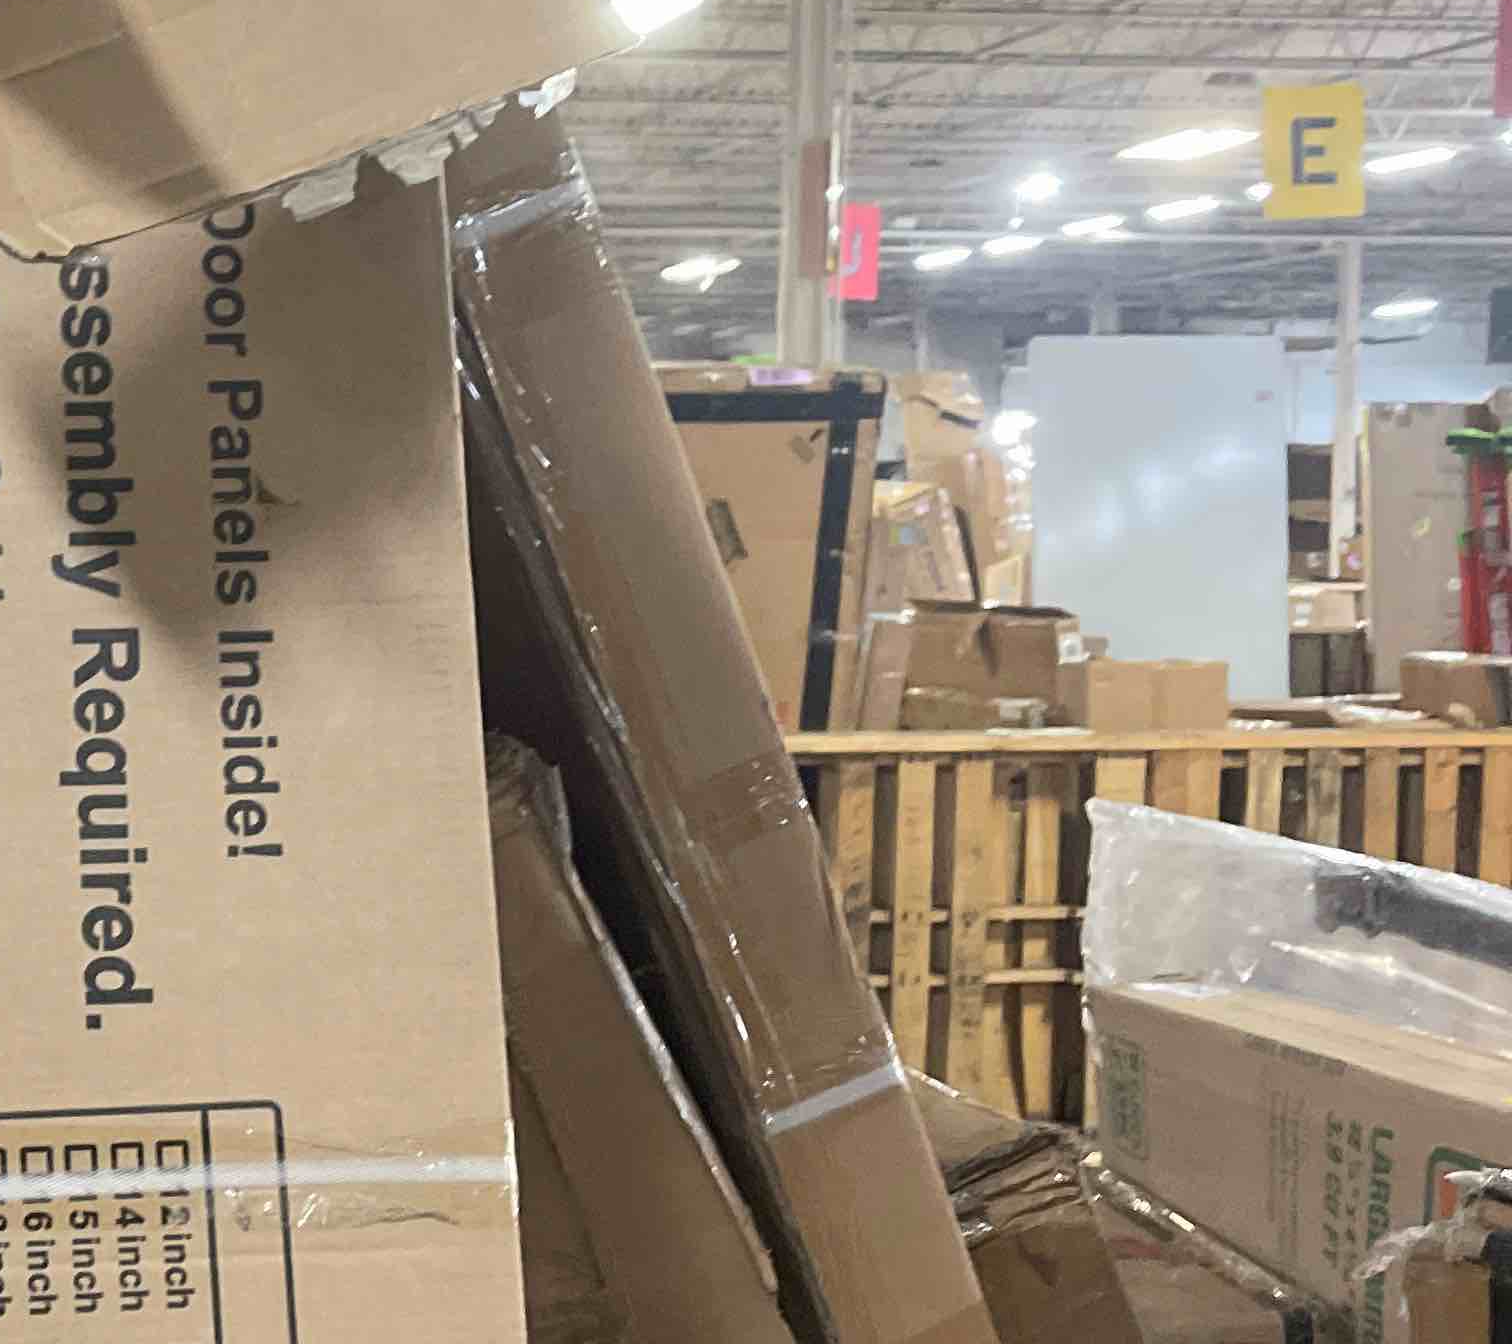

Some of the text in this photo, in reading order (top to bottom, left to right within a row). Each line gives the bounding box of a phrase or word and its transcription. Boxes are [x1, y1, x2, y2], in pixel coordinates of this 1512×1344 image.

[1292, 117, 1337, 184] E
[208, 379, 269, 607] Panels
[51, 261, 154, 1030] ssembly Required.
[219, 630, 283, 858] Inside!
[23, 1192, 58, 1315] 16 inch
[69, 1193, 104, 1313] 15 inch
[114, 1192, 150, 1311] 14 inch
[160, 1189, 195, 1309] 12 inch
